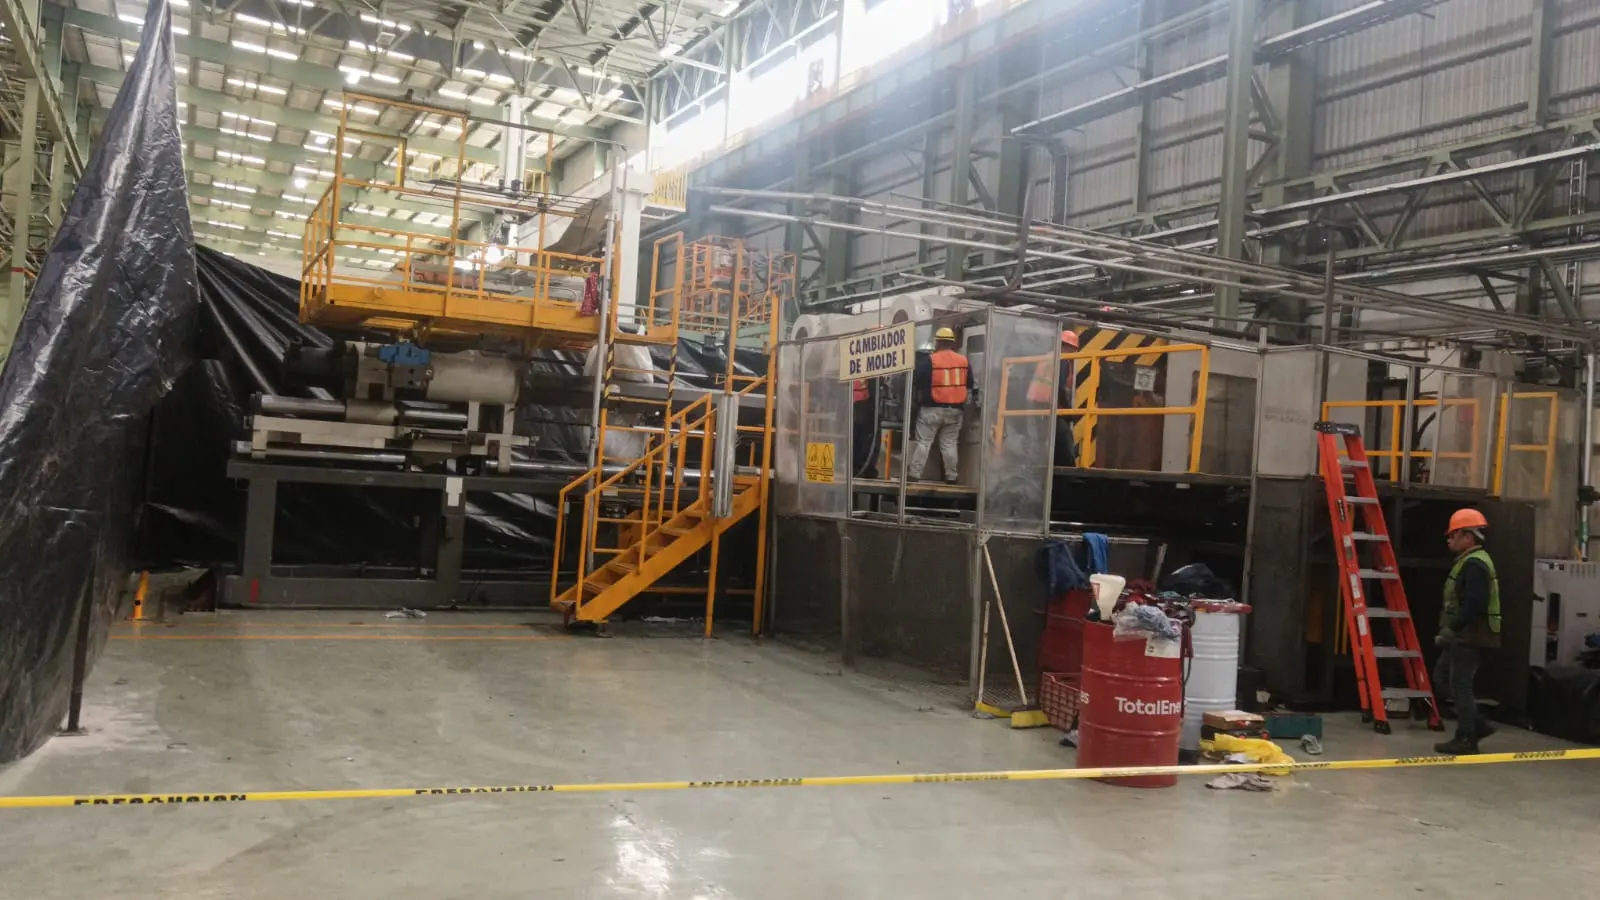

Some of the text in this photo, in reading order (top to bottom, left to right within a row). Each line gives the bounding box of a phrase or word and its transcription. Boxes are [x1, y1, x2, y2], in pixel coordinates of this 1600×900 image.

[849, 328, 905, 356] CAMBIADOR
[849, 358, 861, 375] DE
[866, 350, 897, 372] MOLDE
